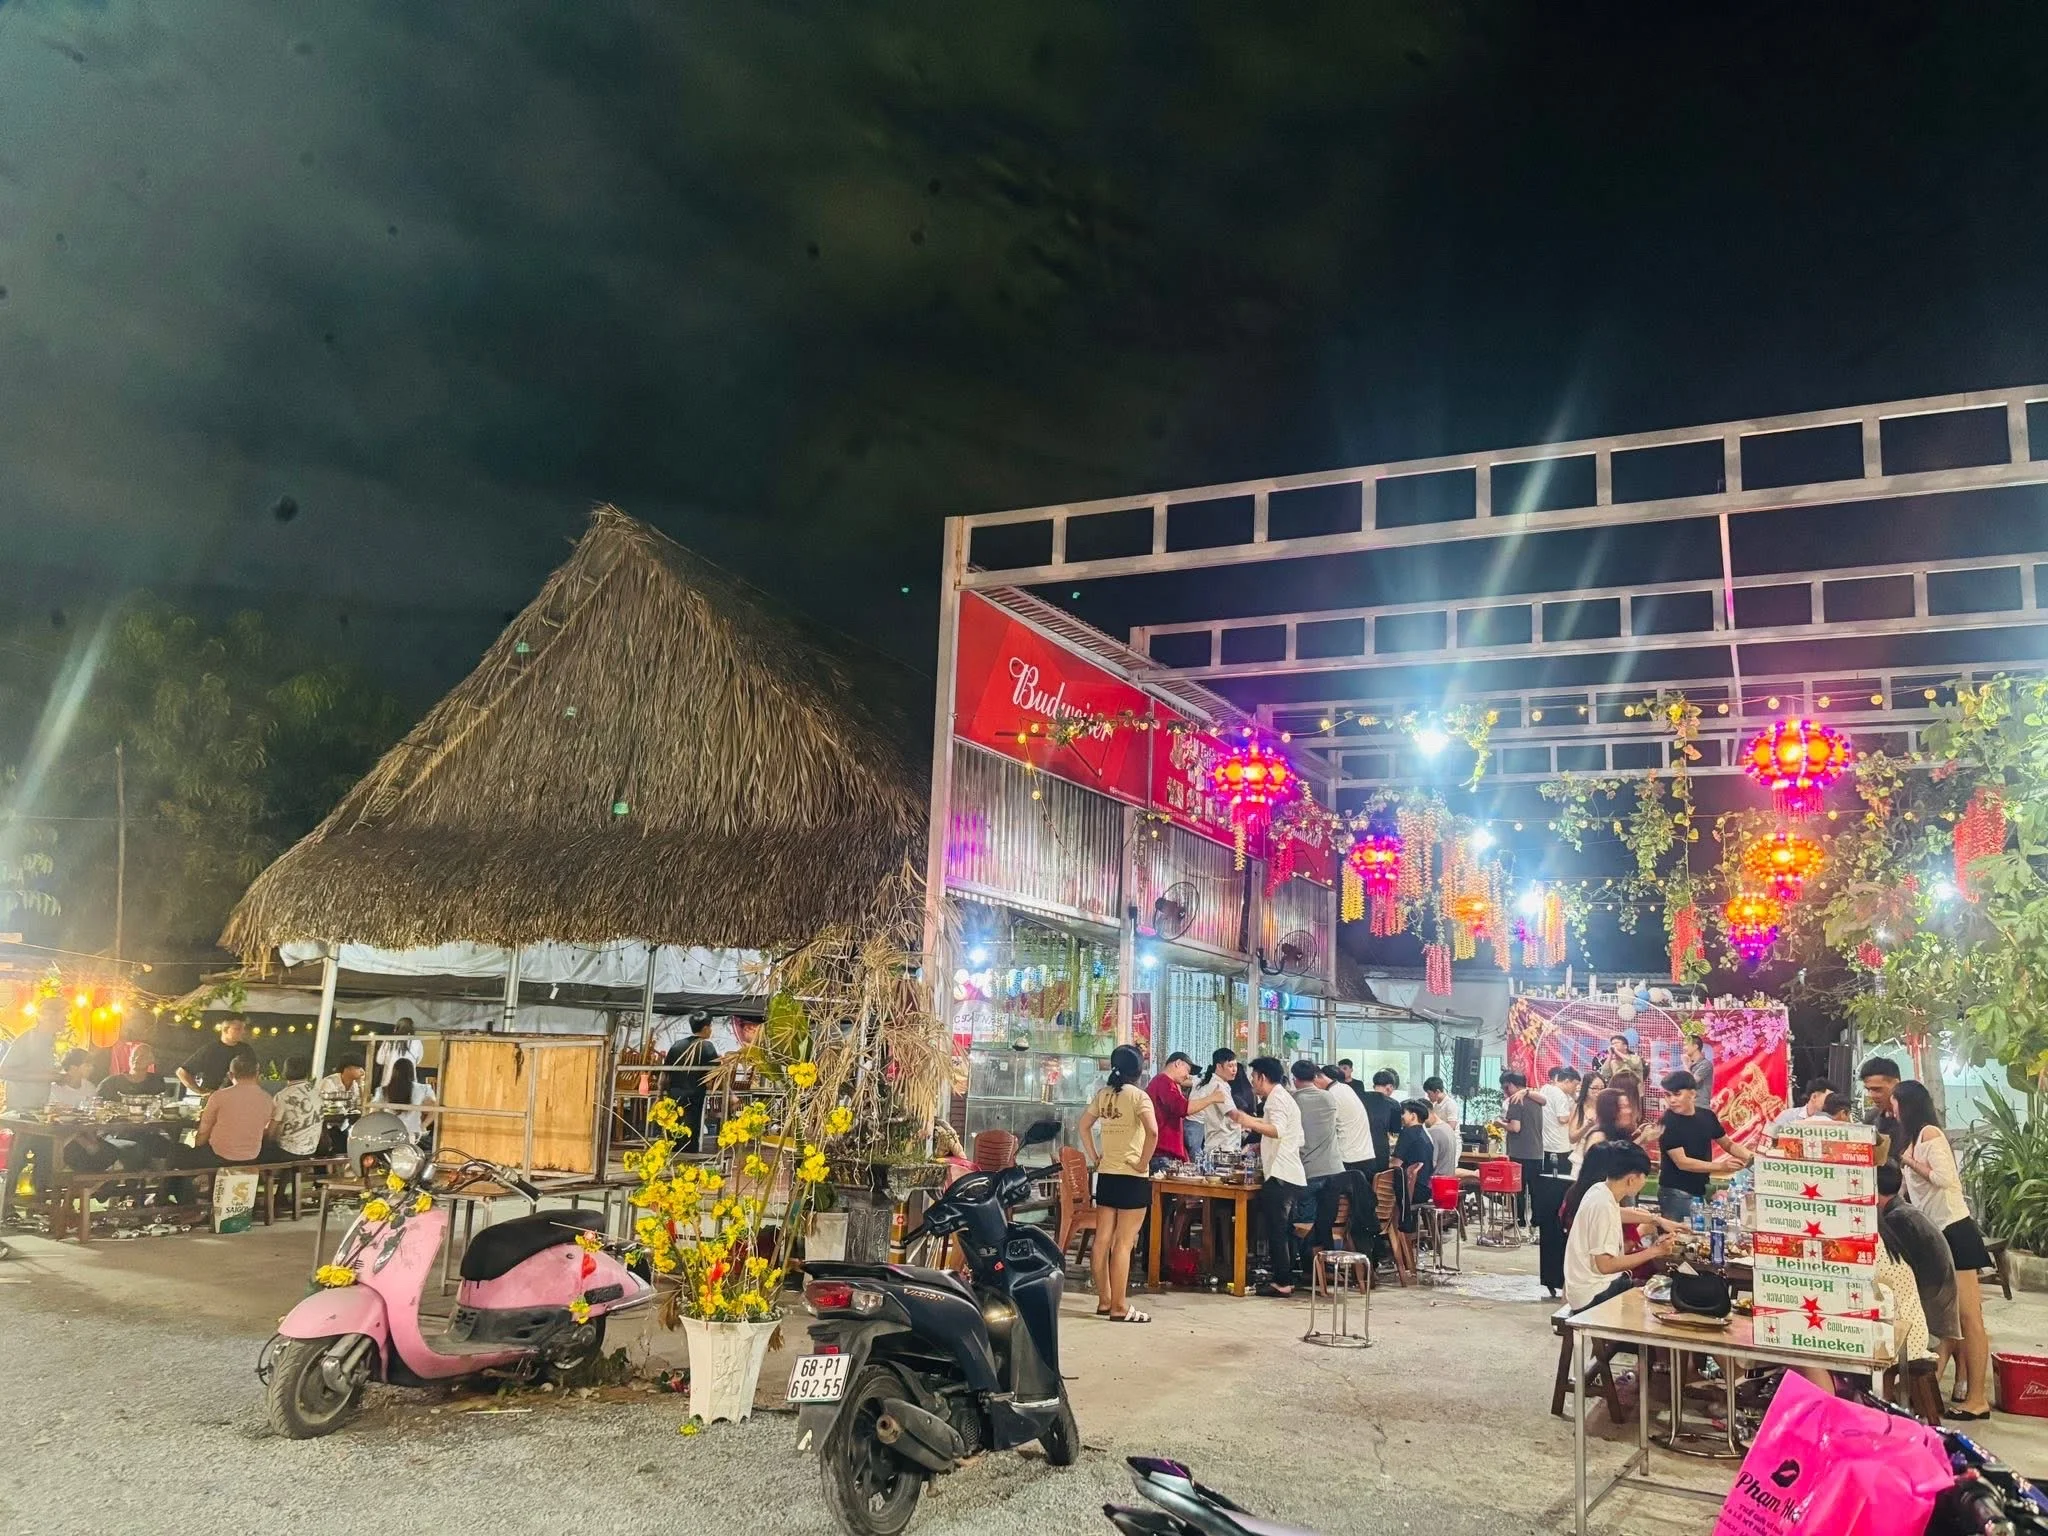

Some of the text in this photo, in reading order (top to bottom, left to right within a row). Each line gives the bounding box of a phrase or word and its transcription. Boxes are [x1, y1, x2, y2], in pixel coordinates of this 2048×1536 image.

[1009, 657, 1111, 741] Budweier
[1763, 1161, 1835, 1180] Heineken
[1765, 1198, 1837, 1217] Heineken
[1776, 1257, 1850, 1275] Heineken
[1762, 1273, 1834, 1293] Heineken
[904, 1288, 945, 1301] VISION
[1792, 1333, 1865, 1354] Heineken
[801, 1357, 841, 1377] 68-P1
[790, 1377, 843, 1398] 692.55
